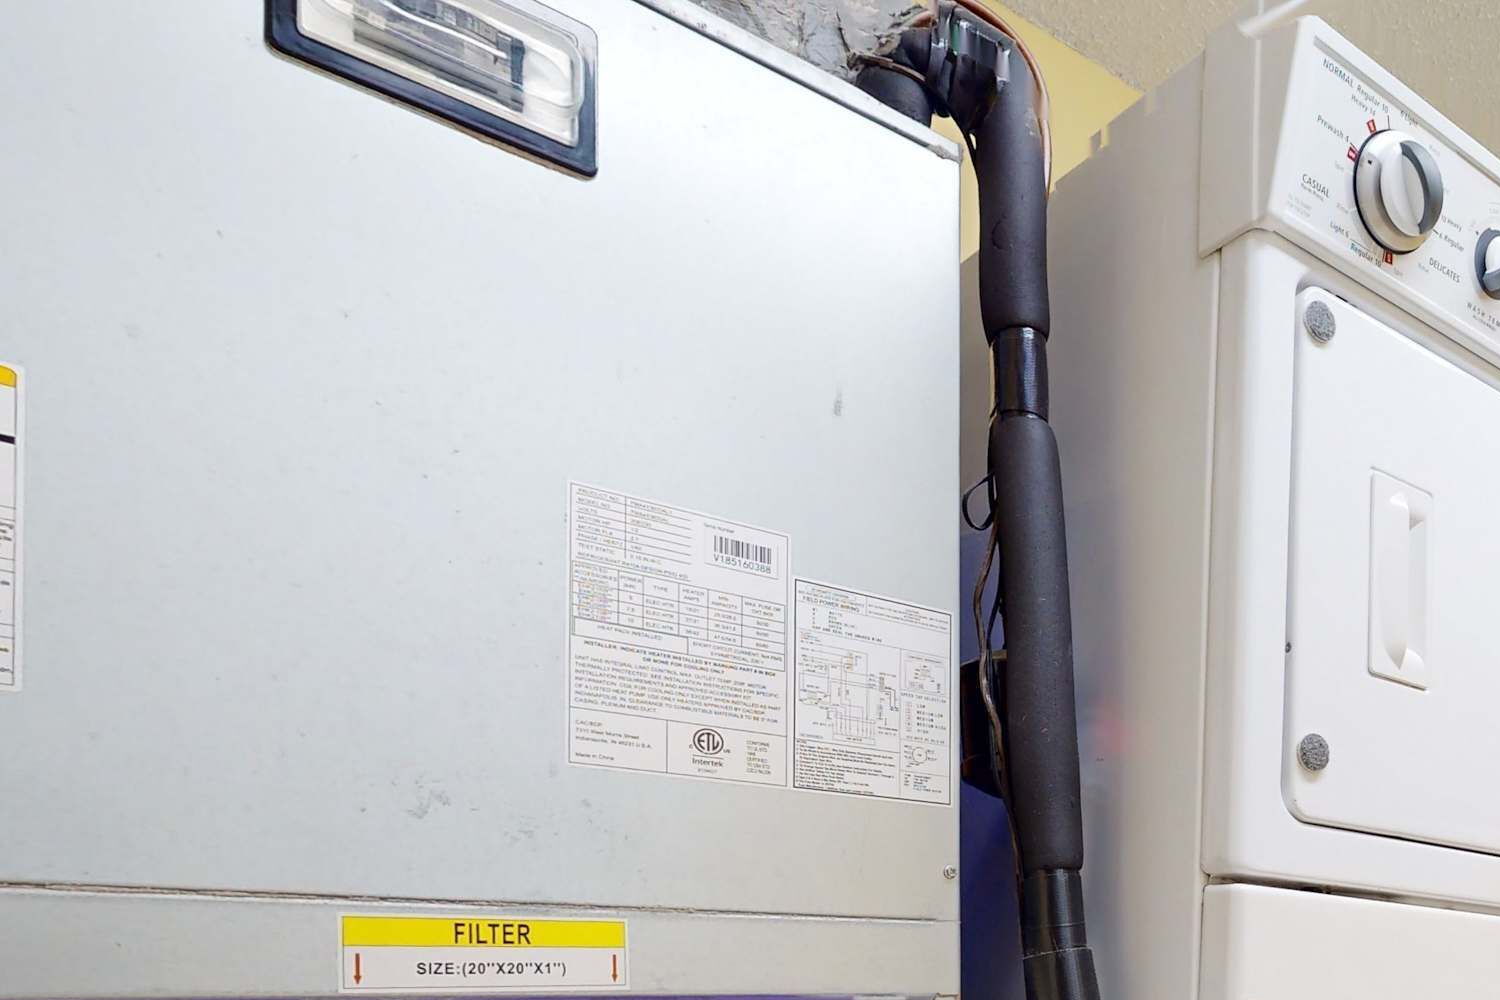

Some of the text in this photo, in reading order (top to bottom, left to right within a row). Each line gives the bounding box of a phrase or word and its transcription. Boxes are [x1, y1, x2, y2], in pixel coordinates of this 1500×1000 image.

[1323, 58, 1353, 88] NORMAL
[1317, 114, 1343, 139] Prewash
[1302, 174, 1329, 198] CASUAL
[1429, 256, 1461, 284] DELICATES
[696, 730, 720, 753] ETL
[691, 757, 723, 767] Intertek
[454, 922, 532, 945] FILTER
